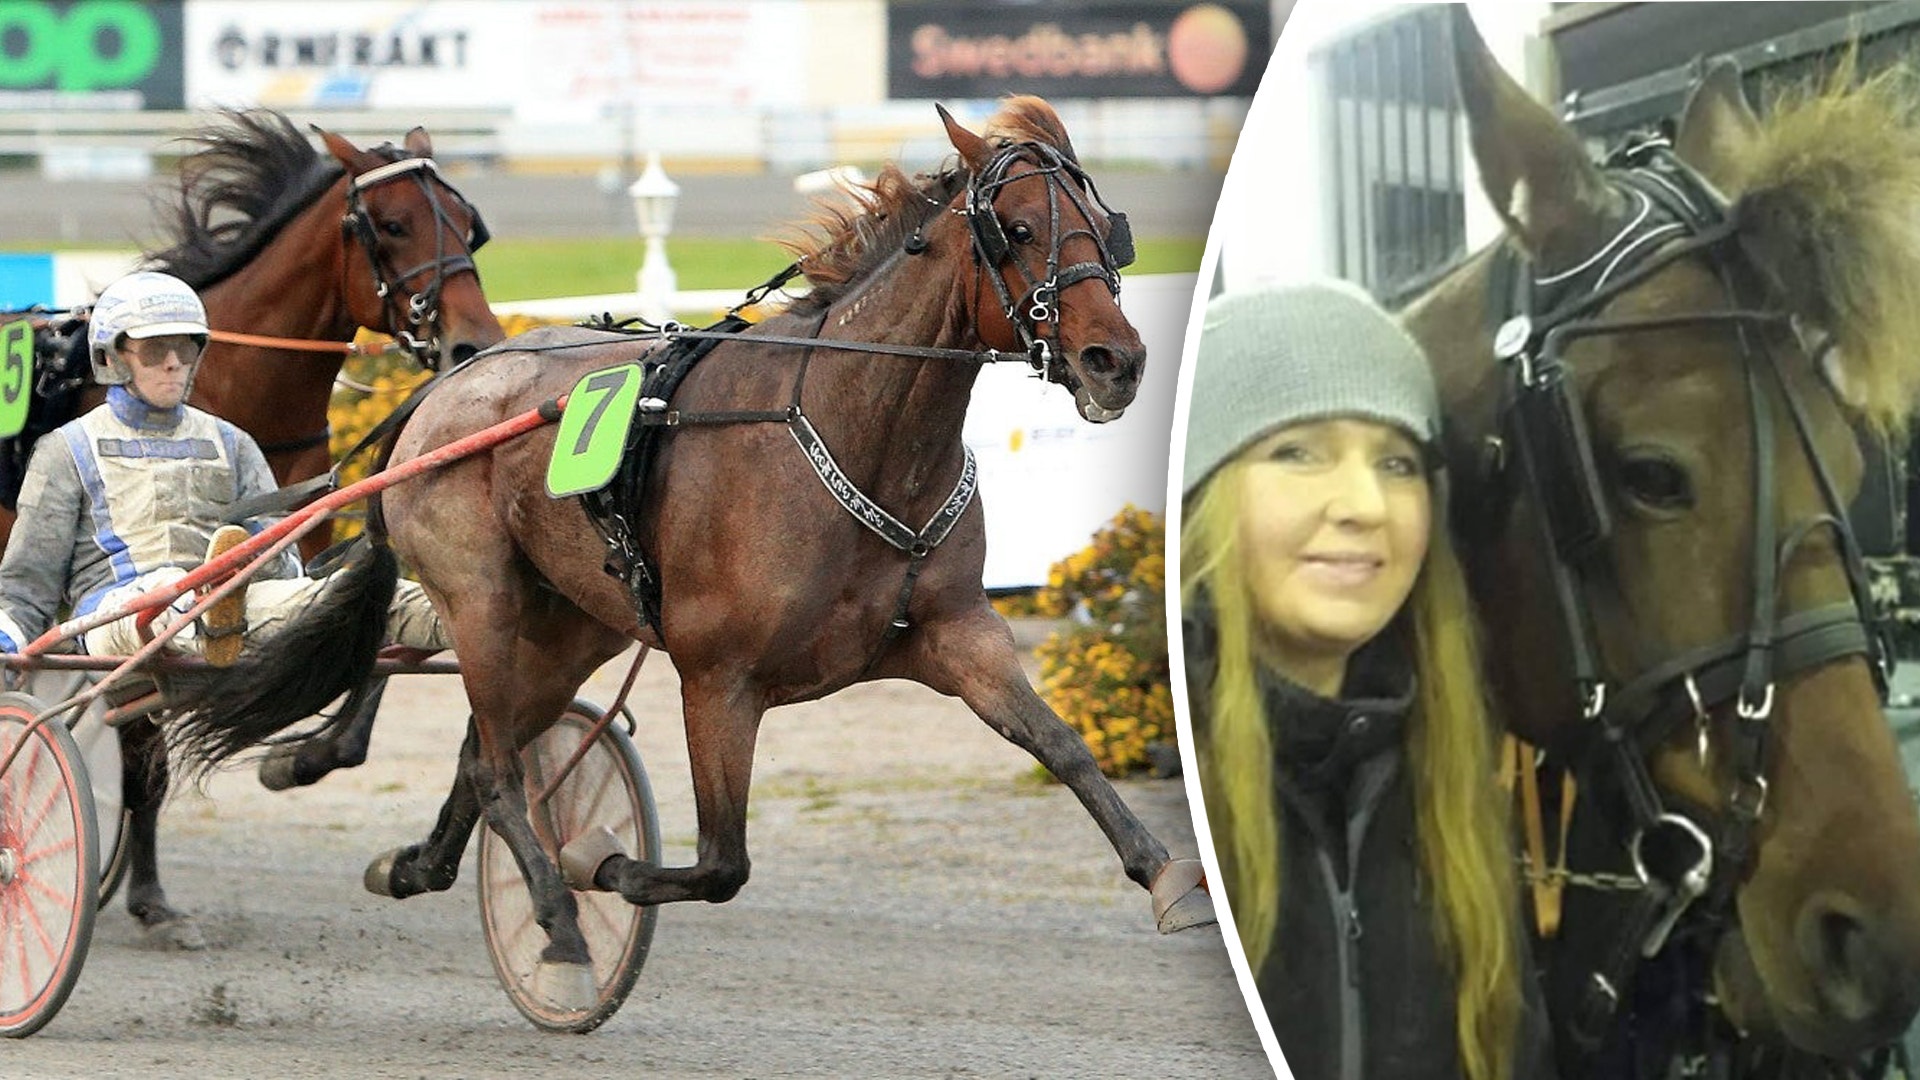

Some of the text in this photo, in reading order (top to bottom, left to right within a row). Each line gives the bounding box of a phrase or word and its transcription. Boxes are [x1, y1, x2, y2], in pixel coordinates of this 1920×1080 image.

[911, 23, 1163, 78] Swedbank
[4, 327, 24, 404] 5
[572, 368, 630, 456] 7
